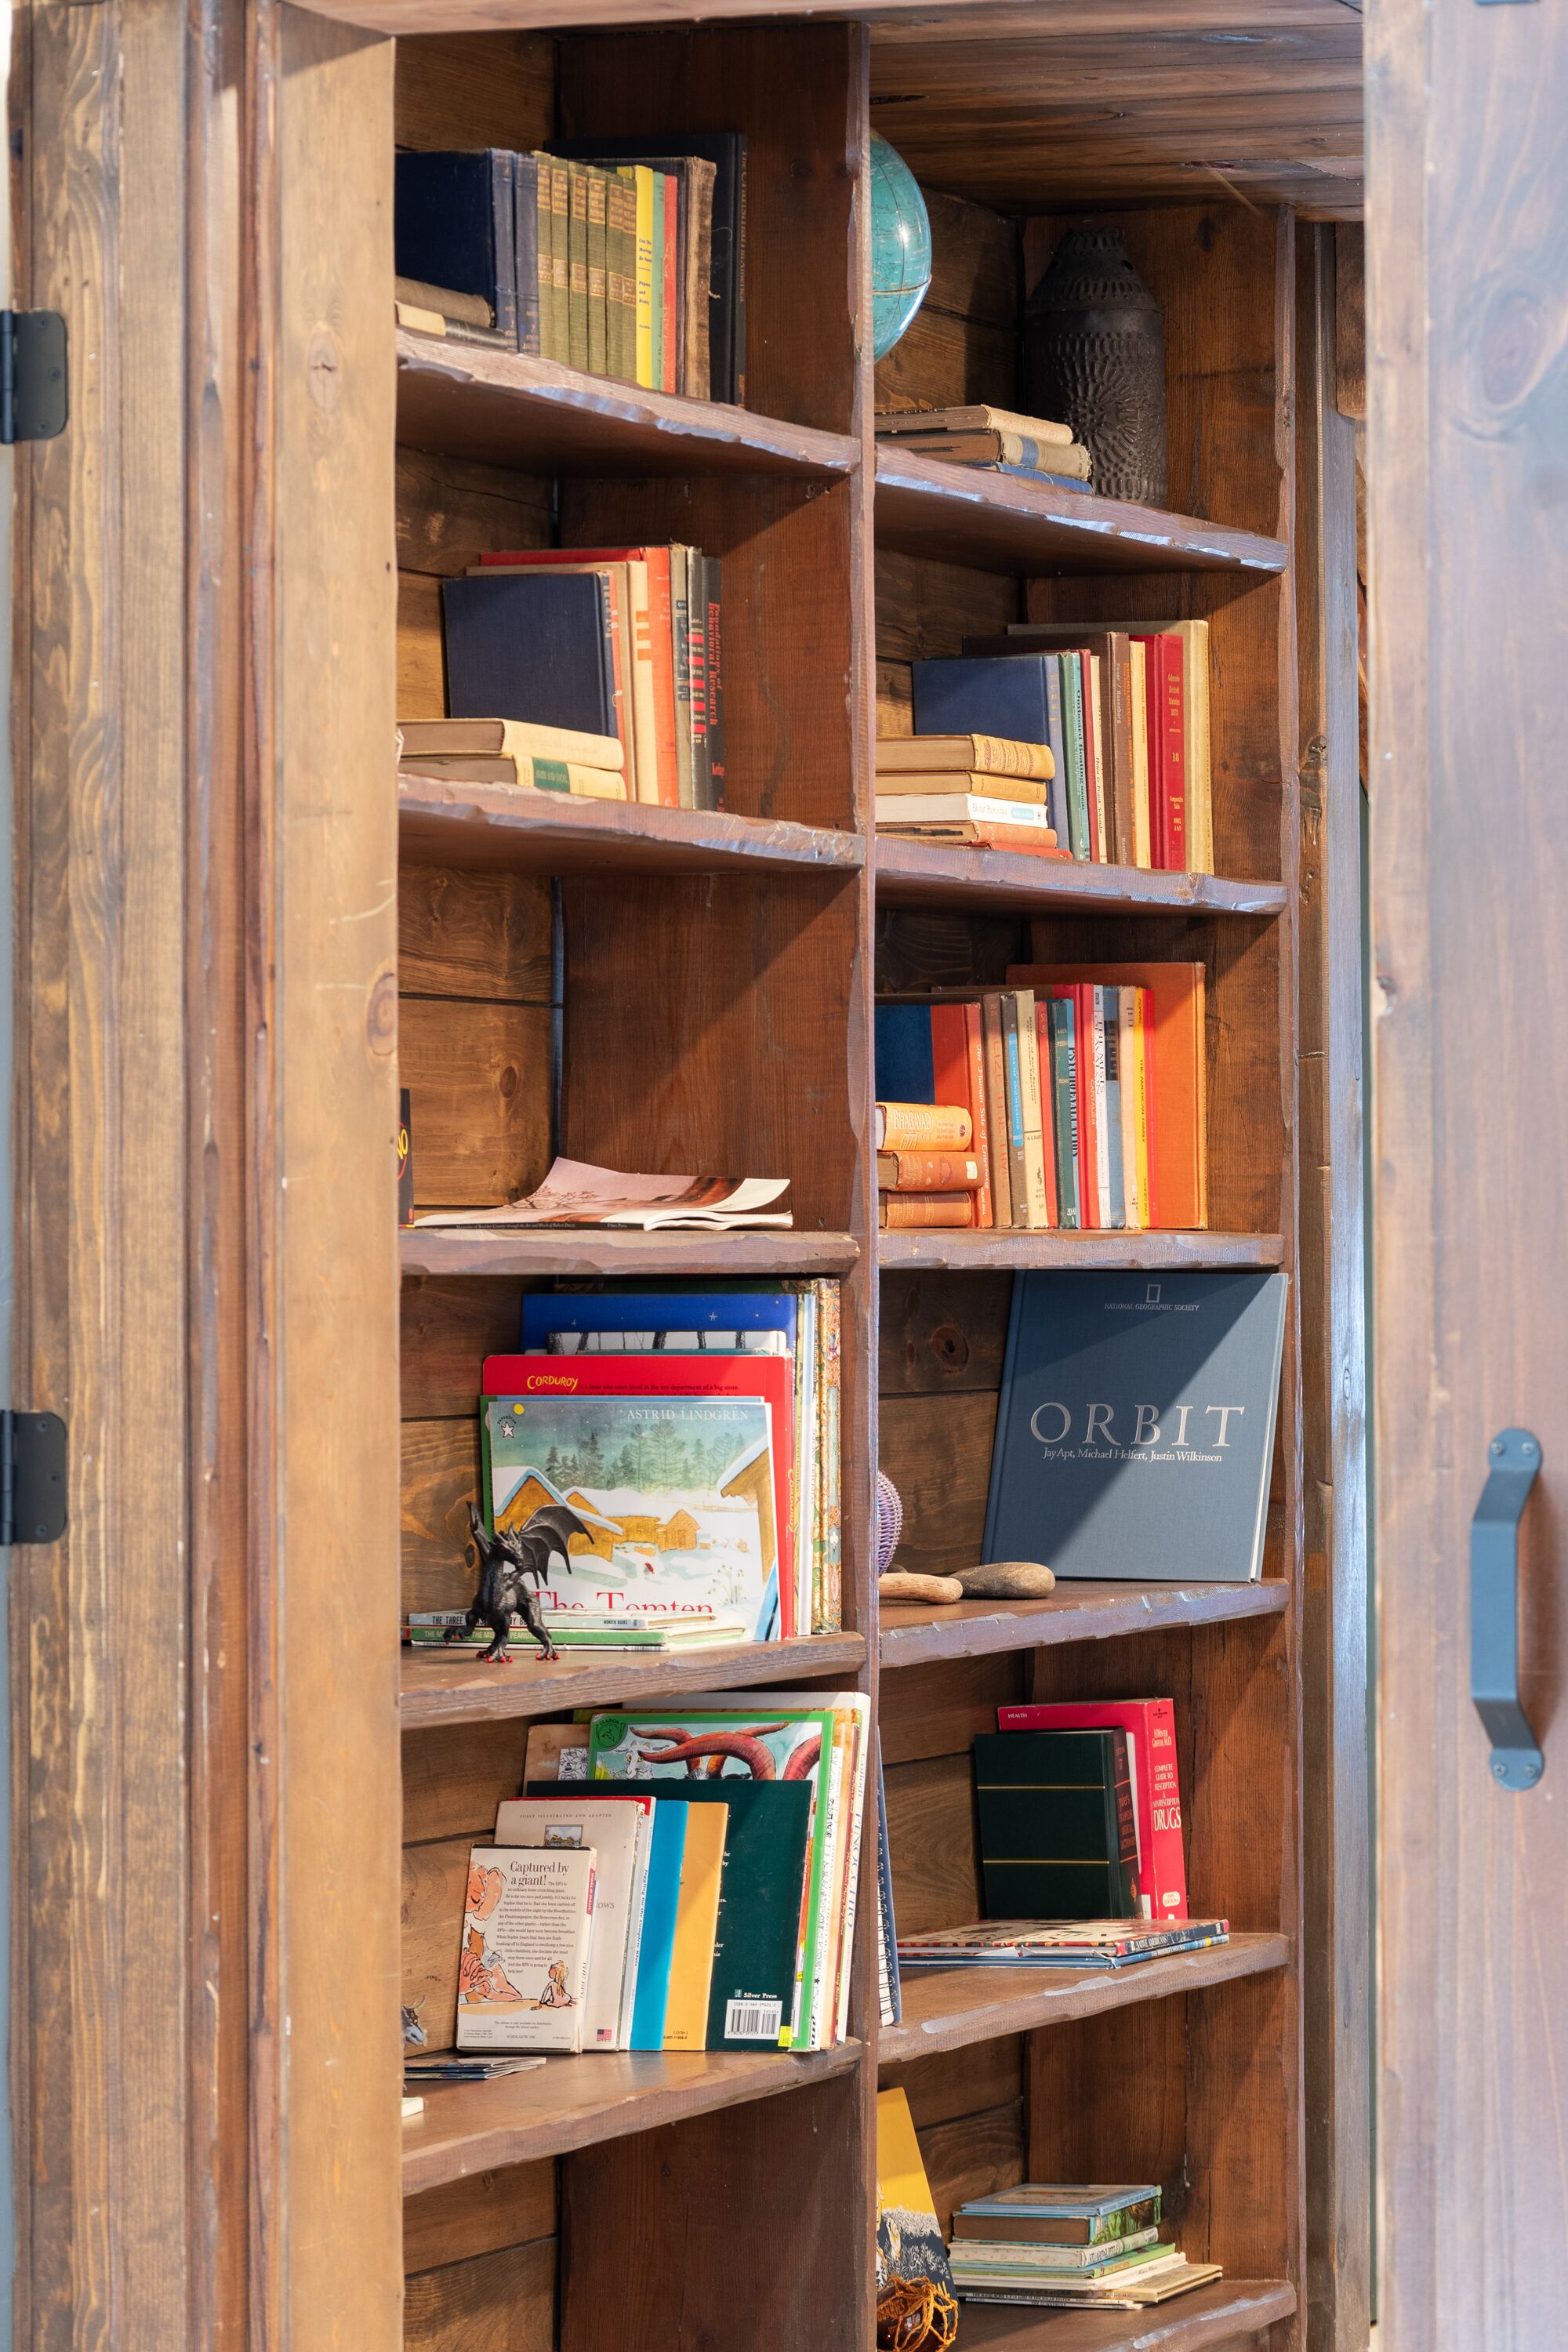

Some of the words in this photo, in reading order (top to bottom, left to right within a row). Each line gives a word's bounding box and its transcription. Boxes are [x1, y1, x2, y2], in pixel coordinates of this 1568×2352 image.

[708, 602, 717, 666] Behavioral
[717, 677, 723, 690] of
[709, 671, 718, 725] Research
[1172, 753, 1179, 763] 18
[893, 1108, 933, 1130] BHAGAVAD
[996, 1096, 1006, 1135] THE
[900, 1132, 918, 1150] GITA
[978, 1130, 986, 1139] of
[527, 1375, 579, 1392] CORDUROY
[626, 1410, 675, 1421] ASTRID
[681, 1410, 748, 1421] LINDGREN
[1030, 1402, 1245, 1447] ORBIT
[1043, 1447, 1057, 1460] Jay
[1057, 1448, 1075, 1460] Apt,
[1077, 1448, 1112, 1459] Michael
[1115, 1448, 1148, 1461] Helfert,
[1149, 1450, 1175, 1462] Justin
[1177, 1451, 1222, 1462] Wilkinson
[787, 1468, 796, 1533] CORDUROY
[536, 1591, 584, 1610] The
[432, 1616, 444, 1625] THE
[446, 1616, 463, 1625] THREE
[1154, 1781, 1176, 1791] PRESCRIPTION
[1153, 1797, 1180, 1807] NONPRESCRIPTION
[1153, 1806, 1181, 1831] DRUGS
[510, 1860, 556, 1875] Captured
[557, 1862, 570, 1875] by
[847, 1813, 861, 1928] PINOCCHIO
[518, 1875, 547, 1887] giant!
